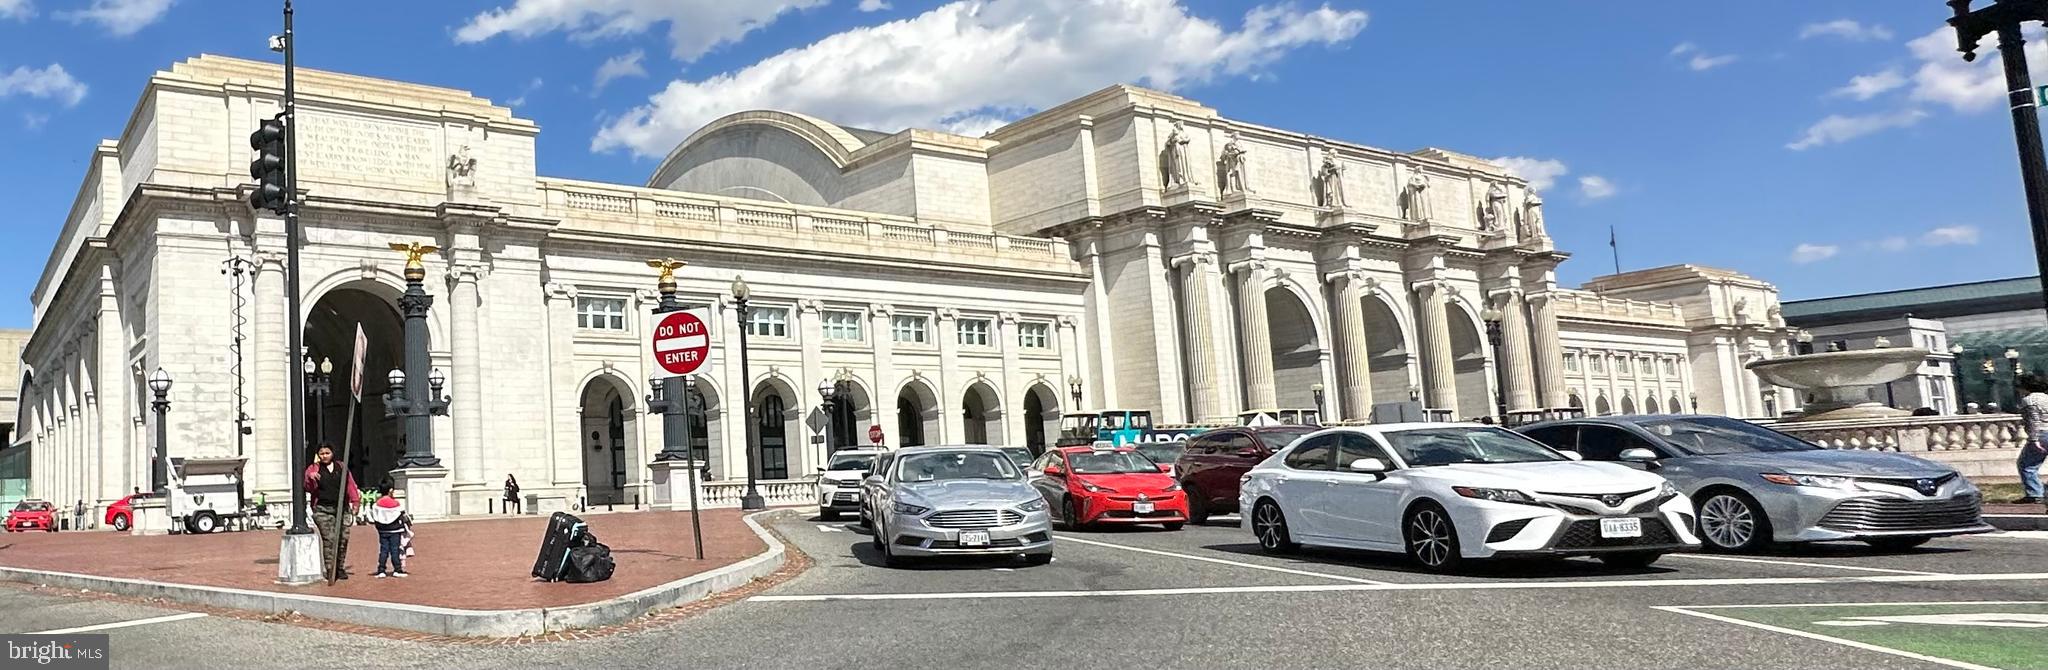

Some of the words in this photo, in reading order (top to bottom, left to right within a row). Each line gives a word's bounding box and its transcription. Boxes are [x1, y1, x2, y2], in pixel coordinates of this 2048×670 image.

[660, 326, 674, 336] DO
[679, 322, 700, 334] NOT
[665, 351, 698, 364] ENTER
